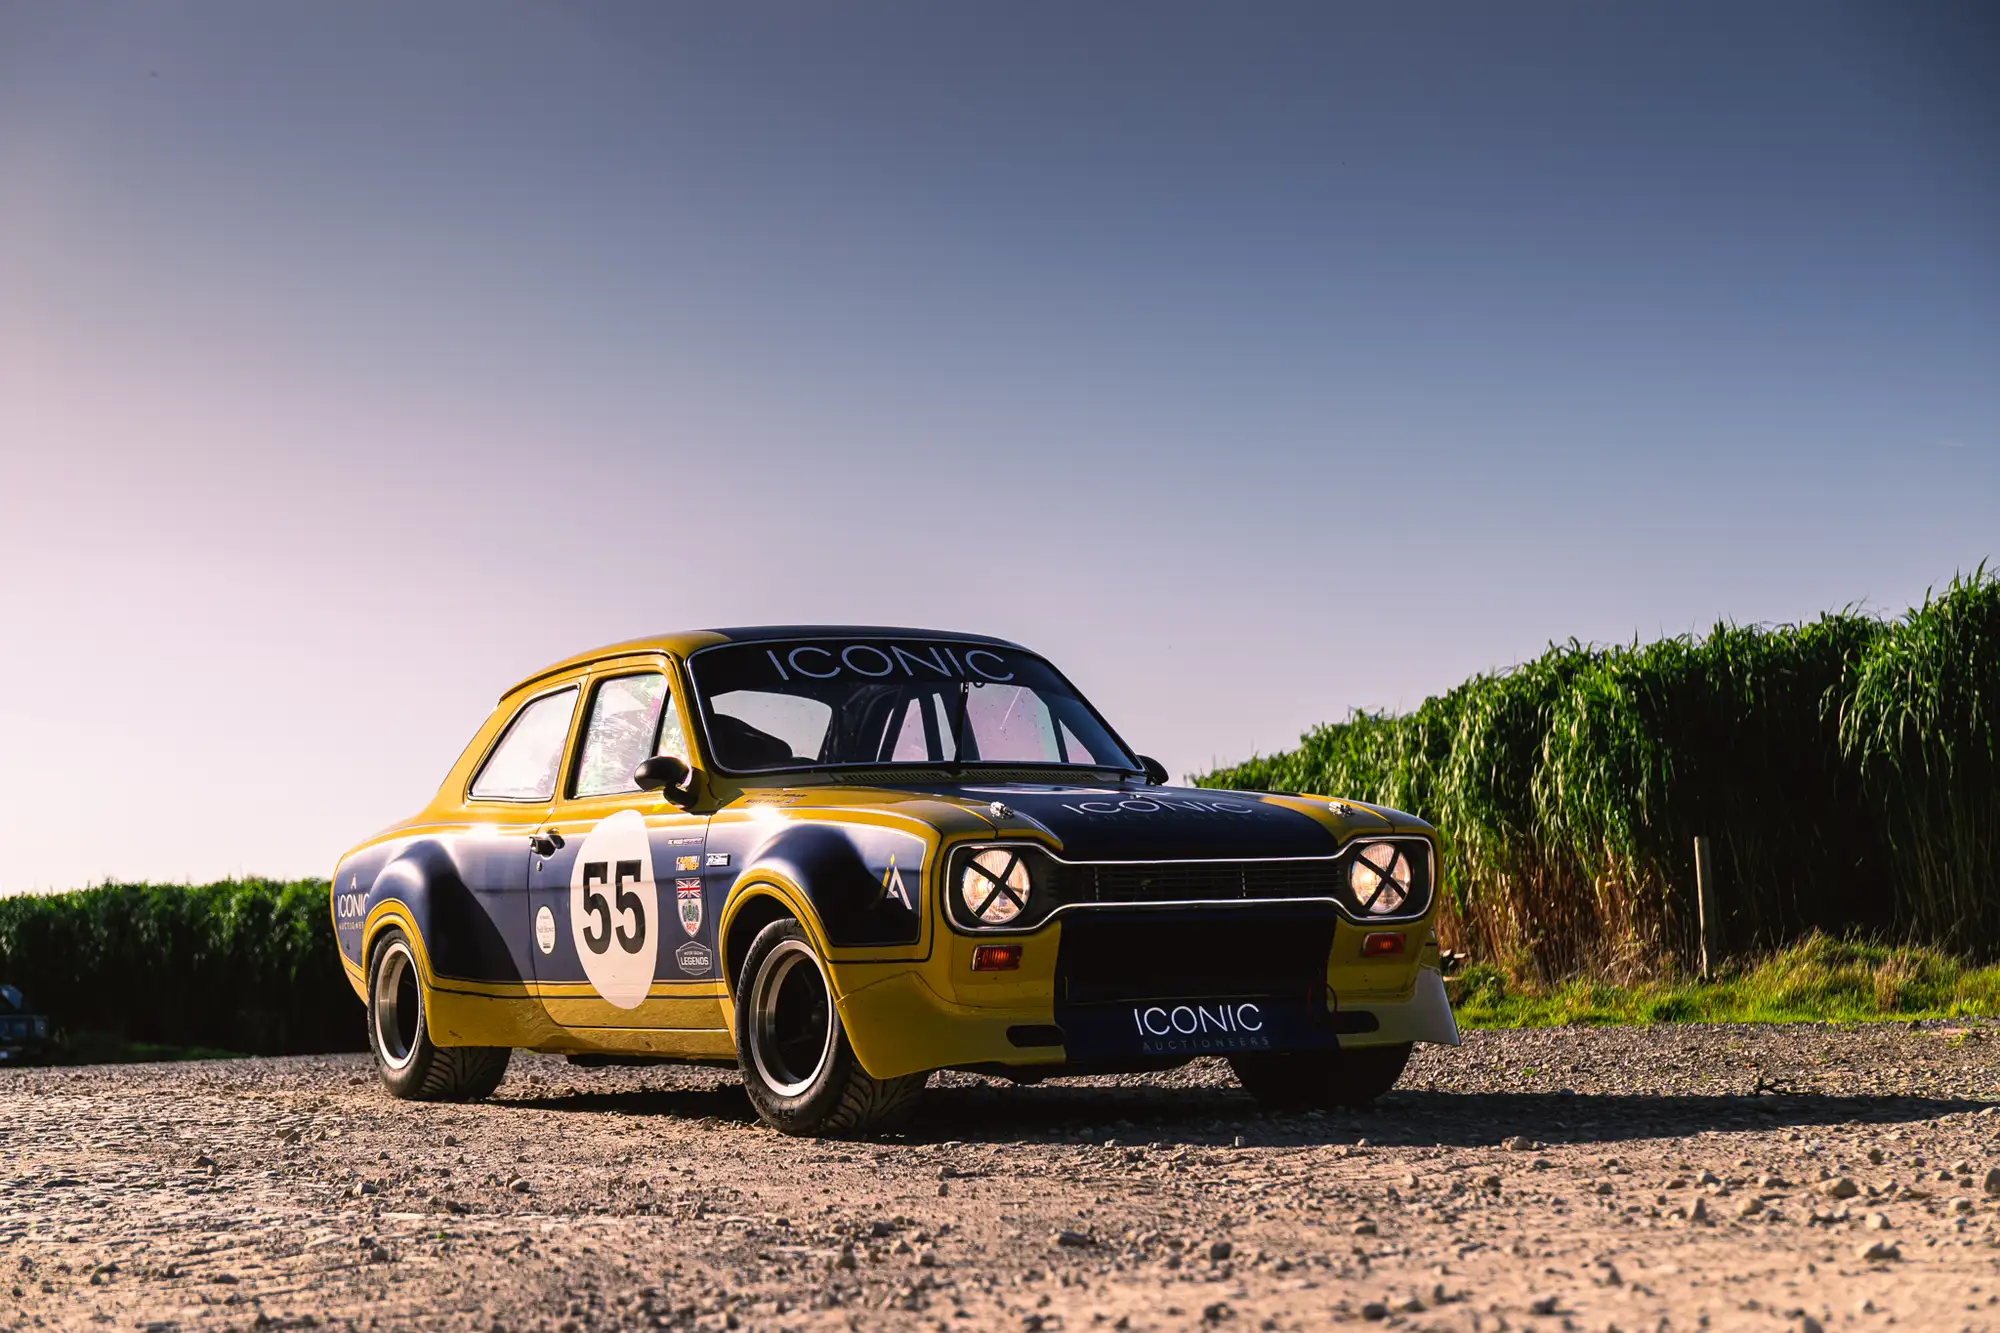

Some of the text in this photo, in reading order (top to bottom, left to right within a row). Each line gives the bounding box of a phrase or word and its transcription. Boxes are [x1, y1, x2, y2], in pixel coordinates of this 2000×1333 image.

[766, 644, 1014, 681] ICONIC
[1061, 800, 1253, 815] ICONIC
[582, 859, 646, 955] 55
[680, 956, 710, 966] LEGENDS
[1134, 1003, 1263, 1036] ICONIC
[1142, 1036, 1270, 1051] AUCTIONEERS
